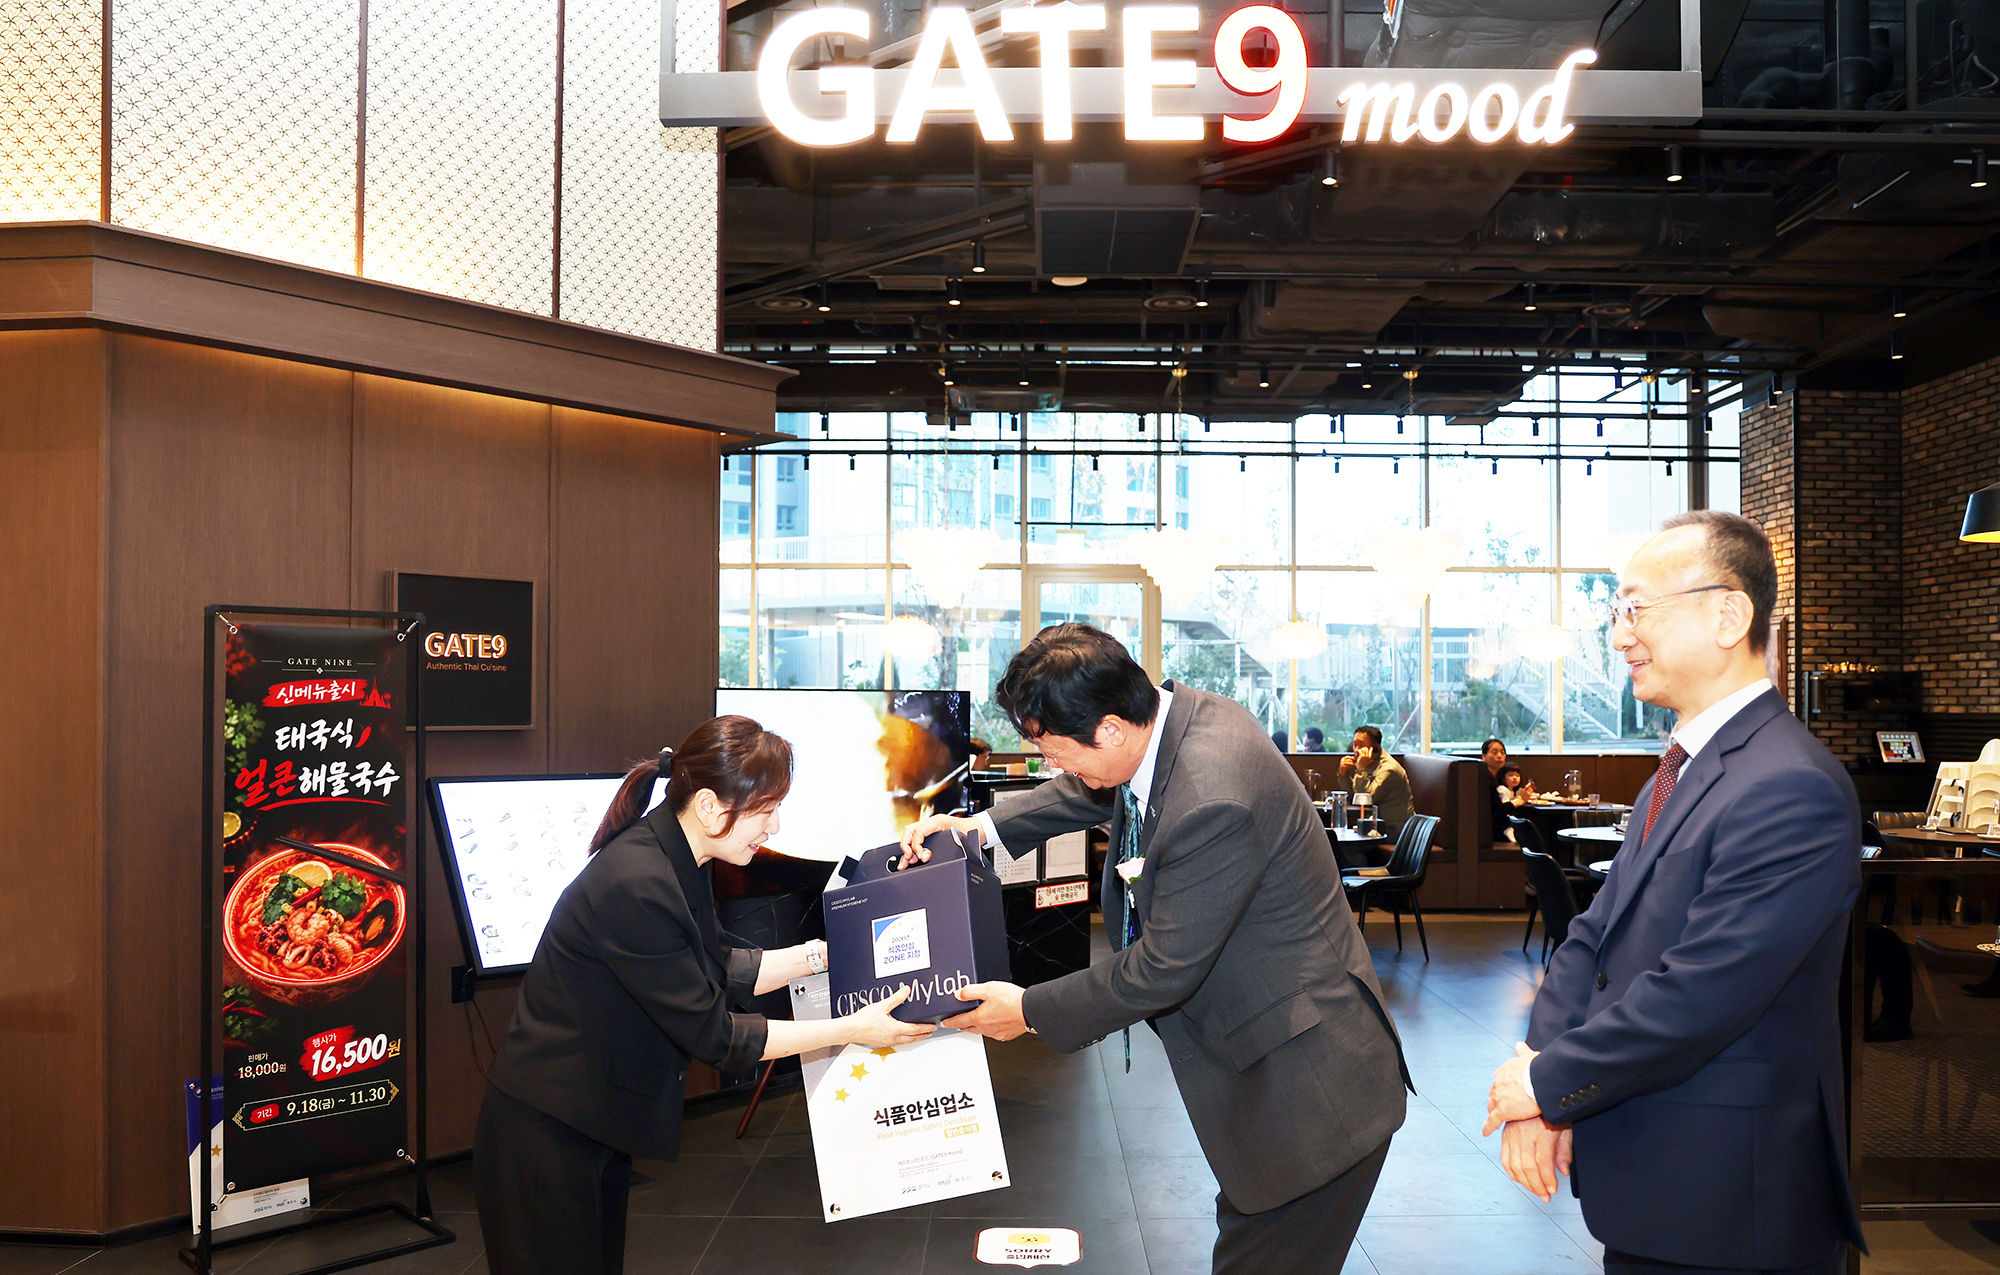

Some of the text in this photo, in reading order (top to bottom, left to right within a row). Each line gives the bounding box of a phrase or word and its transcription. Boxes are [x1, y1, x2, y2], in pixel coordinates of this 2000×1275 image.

[756, 3, 1600, 147] GATE9 mood
[424, 632, 507, 659] GATE9
[288, 658, 353, 667] GATE NINE
[426, 662, 462, 671] Authentic
[464, 663, 479, 671] Thai
[276, 680, 356, 704] 신메뉴출시
[275, 718, 354, 751] 태국식
[883, 950, 921, 964] ZONE 지정
[888, 942, 914, 953] 식품안심
[899, 970, 970, 1005] Mylab
[311, 1033, 337, 1048] 행사가
[238, 1061, 287, 1079] 18,000원
[257, 1108, 273, 1119] 기간
[287, 1098, 335, 1116] 9.18(금)
[350, 1086, 387, 1105] 11.30
[873, 1092, 975, 1127] 식품안심업소
[877, 1114, 978, 1140] Food Hygiene Safety Certificate
